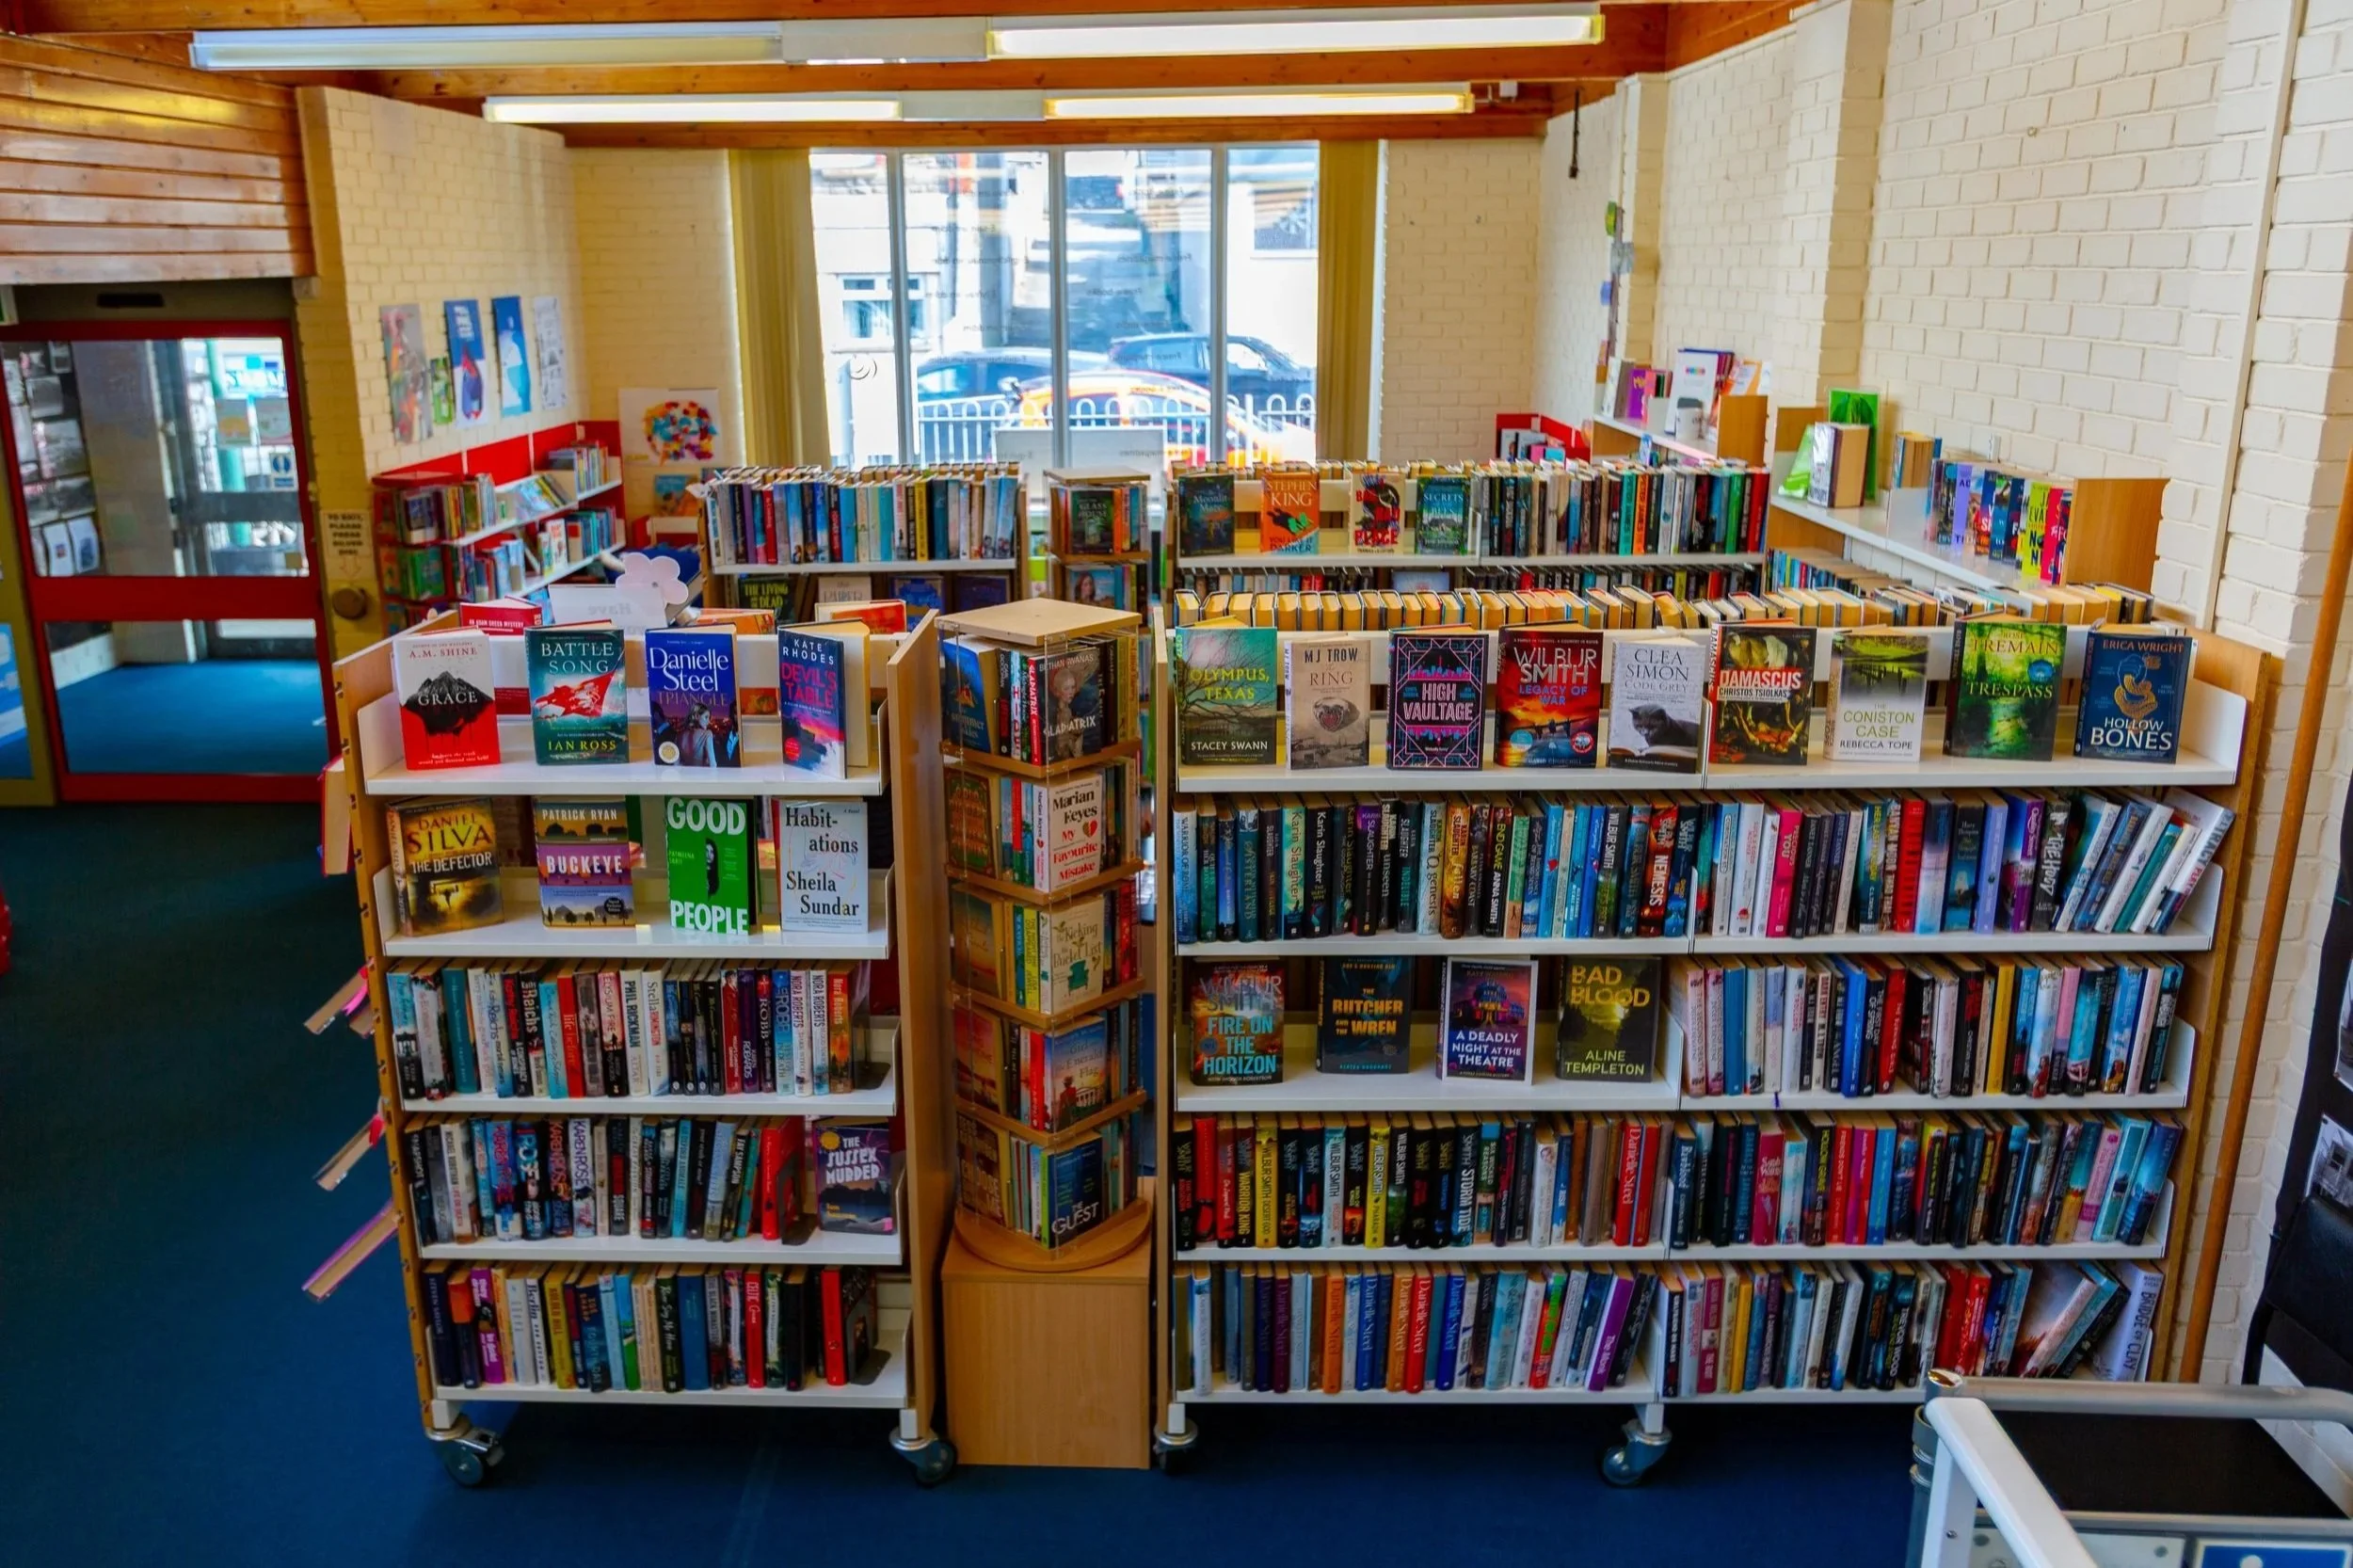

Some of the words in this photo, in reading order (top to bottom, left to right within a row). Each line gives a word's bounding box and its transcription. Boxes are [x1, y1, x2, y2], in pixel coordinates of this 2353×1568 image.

[1264, 481, 1318, 490] STEPHEN
[1271, 492, 1312, 506] KING
[760, 596, 783, 607] DEAD
[440, 648, 477, 657] SHINE
[541, 643, 614, 656] BATTLE
[793, 639, 823, 652] KATE
[1327, 648, 1358, 662] TROW
[1972, 639, 2058, 656] TREMAIN
[2103, 640, 2135, 651] ERICA
[2137, 641, 2185, 653] WRIGHT
[549, 660, 610, 674] SONG
[649, 648, 729, 671] Danielle
[782, 648, 835, 665] RHODES
[1513, 647, 1597, 668] WILBUR
[1635, 648, 1683, 665] CLEA
[663, 664, 719, 692] Steel
[780, 663, 838, 692] DEVIL'S
[1190, 668, 1271, 684] OLYMPUS,
[1310, 672, 1353, 686] RING
[1520, 664, 1590, 684] SMITH
[1625, 664, 1689, 681] SIMON
[1720, 670, 1801, 690] DAMASCUS
[786, 682, 834, 710] TABLE
[1205, 688, 1256, 700] TEXAS
[1421, 682, 1456, 700] HIGH
[1518, 685, 1566, 696] LEGACY
[1571, 686, 1588, 696] OF
[1625, 680, 1654, 692] CODE
[1658, 681, 1689, 693] GREY
[1720, 688, 1753, 698] CHRISTOS
[1754, 689, 1788, 698] TSIOLKAS
[1966, 681, 2054, 699] TRESPASS
[418, 692, 477, 707] GRACE
[658, 693, 728, 706] TRIANGLE
[1540, 696, 1566, 705] WAR
[1402, 702, 1474, 721] VAULTAGE
[1843, 711, 1915, 724] CONISTON
[1855, 726, 1901, 739] CASE
[2105, 716, 2164, 731] HOLLOW
[548, 741, 575, 750] IAN
[580, 741, 616, 750] ROSS
[1191, 742, 1228, 751] STACEY
[1231, 741, 1268, 750] SWANN
[1839, 740, 1884, 749] REBECCA
[1887, 741, 1913, 750] TOPE
[2090, 728, 2173, 751] BONES
[1052, 791, 1096, 809] Marian
[418, 812, 477, 830] DANIEL
[542, 809, 585, 821] PATRICK
[591, 808, 617, 821] RYAN
[667, 797, 746, 836] GOOD
[785, 807, 839, 828] Habit-
[1064, 805, 1098, 824] Keyes
[1317, 811, 1327, 838] Karin
[1061, 828, 1076, 842] My
[1291, 811, 1303, 844] Karin
[1379, 803, 1390, 851] SLAUGHTER
[1605, 812, 1620, 844] WILBUR
[408, 824, 492, 855] SILVA
[808, 834, 858, 854] ations
[1364, 820, 1376, 872] SLAUGHTER
[1400, 818, 1410, 858] SLAUGHTER
[411, 857, 432, 874] THE
[434, 851, 492, 872] DEFECTOR
[1052, 841, 1098, 864] Favourite
[1314, 839, 1326, 884] Slaughter
[1602, 843, 1616, 870] SMITH
[546, 855, 623, 874] BUCKEYE
[1058, 859, 1096, 881] Mistake
[1287, 846, 1303, 900] Slaughter
[787, 871, 837, 892] Sheila
[1381, 853, 1392, 898] unseen
[1492, 871, 1501, 898] ANNA
[1648, 854, 1670, 907] NEMESIS
[800, 895, 859, 917] Sundar
[1489, 897, 1499, 924] SMITH
[670, 899, 749, 936] PEOPLE
[811, 974, 824, 993] NORA
[1571, 965, 1623, 986] BAD
[624, 981, 636, 1004] PHIL
[647, 982, 660, 1012] Stella
[1570, 987, 1651, 1008] BLOOD
[521, 988, 542, 1034] Reichs
[792, 993, 805, 1029] ROBERTS
[813, 993, 825, 1028] ROBERTS
[1333, 999, 1403, 1016] BUTCHER
[626, 1004, 641, 1048] RICKMAN
[1208, 1016, 1246, 1035] FIRE
[1250, 1016, 1273, 1034] ON
[1351, 1019, 1397, 1036] WREN
[1225, 1036, 1255, 1055] THE
[1456, 1031, 1465, 1040] A
[1468, 1031, 1518, 1044] DEADLY
[1452, 1043, 1489, 1054] NIGHT
[1491, 1047, 1503, 1055] AT
[1504, 1048, 1521, 1056] THE
[1585, 1049, 1626, 1063] ALINE
[1203, 1056, 1276, 1075] HORIZON
[1458, 1053, 1514, 1068] THEATRE
[1564, 1062, 1644, 1077] TEMPLETON
[573, 1120, 586, 1156] KAREN
[842, 1136, 860, 1147] THE
[1397, 1132, 1408, 1161] WILBUR
[826, 1147, 878, 1167] SUSSEX
[1331, 1143, 1342, 1173] WILBUR
[1373, 1143, 1385, 1173] WILBUR
[1624, 1128, 1641, 1176] Danielle
[574, 1155, 590, 1186] ROSE
[825, 1163, 881, 1185] MURDER
[1395, 1160, 1407, 1185] SMITH
[1328, 1172, 1340, 1198] SMITH
[1371, 1172, 1384, 1195] SMITH
[1460, 1168, 1475, 1205] STORM
[1051, 1201, 1099, 1235] GUEST
[1238, 1213, 1251, 1236] KING
[1364, 1276, 1378, 1320] Danielle
[1398, 1276, 1413, 1320] Danielle
[1417, 1278, 1432, 1320] Danielle
[2133, 1290, 2157, 1330] BRIDGE
[1362, 1320, 1374, 1352] Steel
[1413, 1320, 1427, 1354] Steel
[2122, 1343, 2142, 1370] CLAY
